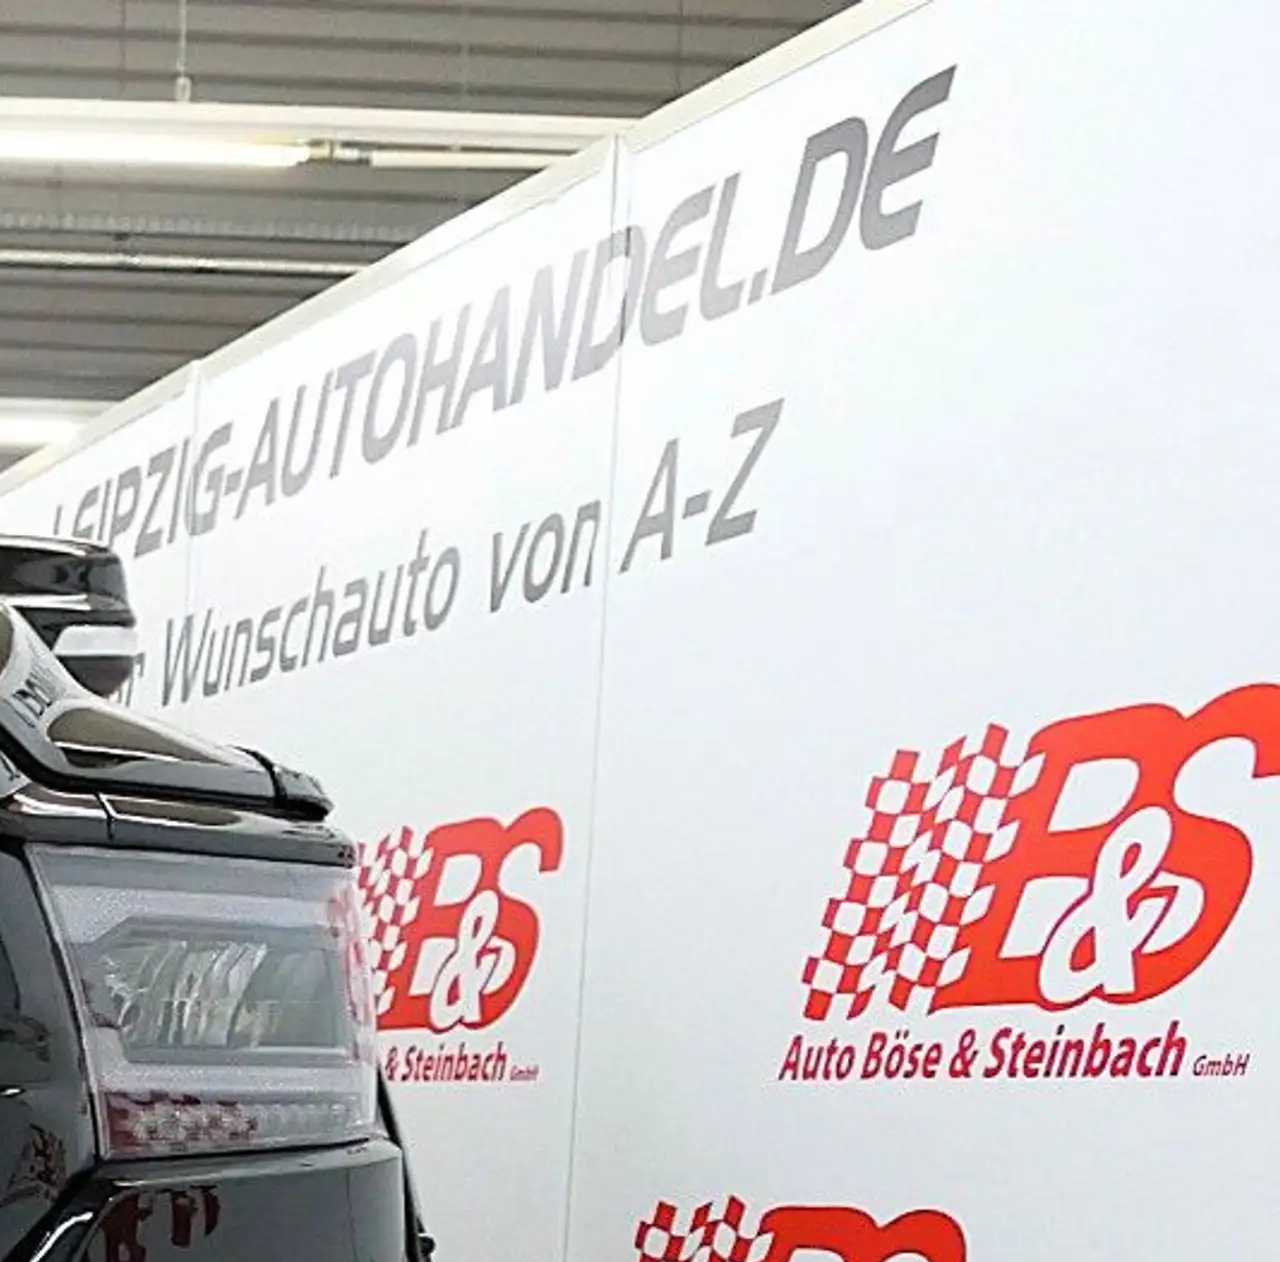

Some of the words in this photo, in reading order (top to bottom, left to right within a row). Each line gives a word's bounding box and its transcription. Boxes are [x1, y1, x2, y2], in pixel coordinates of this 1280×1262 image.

[162, 538, 462, 708] Wunschauto
[490, 499, 603, 614] von
[618, 398, 787, 574] A-Z
[401, 1040, 507, 1081] Steinbach
[778, 1034, 855, 1081] Auto
[860, 1030, 941, 1079] Böse
[948, 1028, 979, 1078] &
[982, 1020, 1188, 1079] Steinbach
[1192, 1053, 1250, 1077] GmbH
